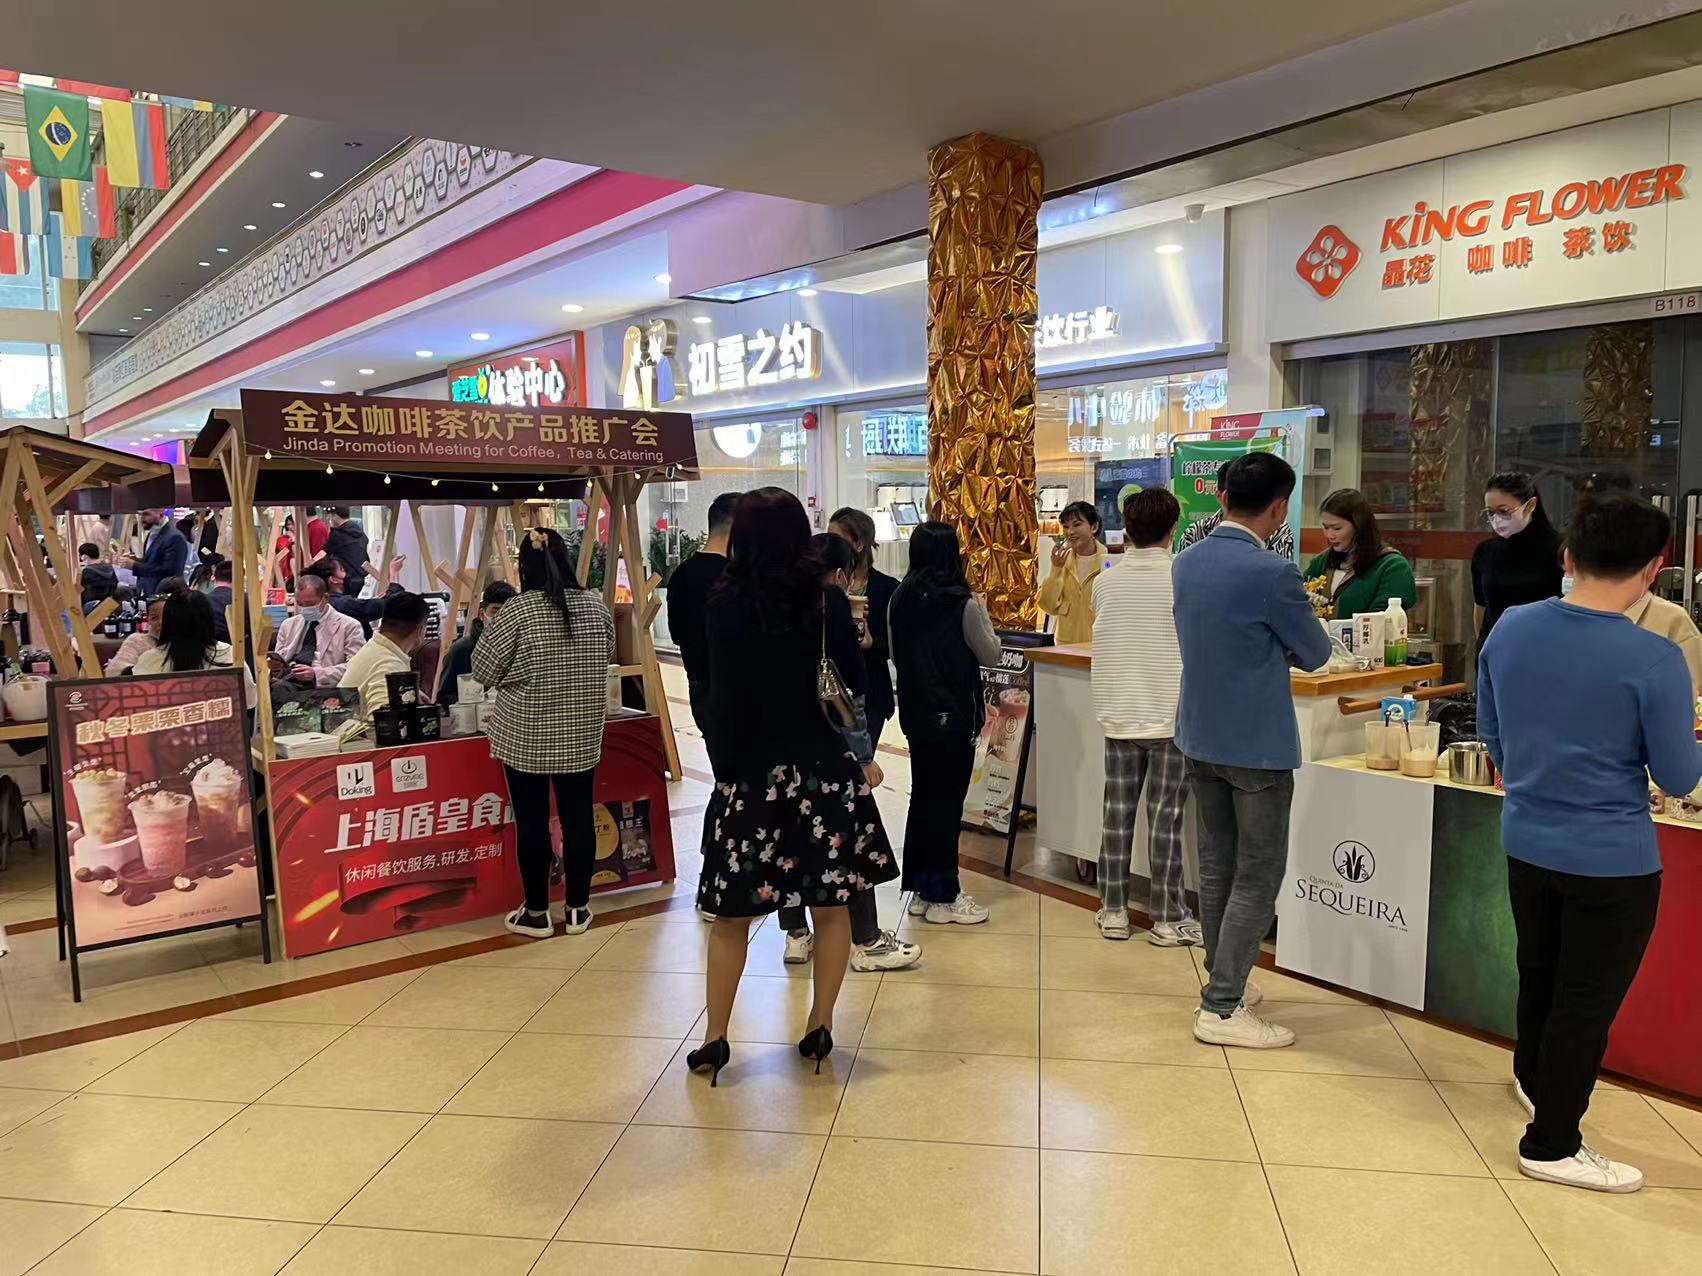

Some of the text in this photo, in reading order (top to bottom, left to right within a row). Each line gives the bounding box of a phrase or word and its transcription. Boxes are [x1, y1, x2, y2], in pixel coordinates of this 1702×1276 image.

[1501, 163, 1687, 231] FLOWER
[1466, 236, 1533, 274] 咖啡
[1561, 219, 1634, 259] 茶饮
[1655, 295, 1697, 312] B118
[688, 320, 816, 396] 初雪之约
[487, 358, 566, 407] 体验中心
[281, 399, 659, 447] 金达咖啡茶饮产品推广会
[283, 437, 328, 451] Jinda
[333, 438, 418, 455] Promotion
[420, 442, 481, 458] Meeting
[485, 443, 503, 456] for
[568, 446, 594, 460] Tea
[596, 448, 607, 460] &
[608, 448, 664, 462] Catering
[340, 785, 373, 797] Doking
[1295, 878, 1407, 926] SEQUEIRA
[1309, 875, 1344, 889] QUINTA DA
